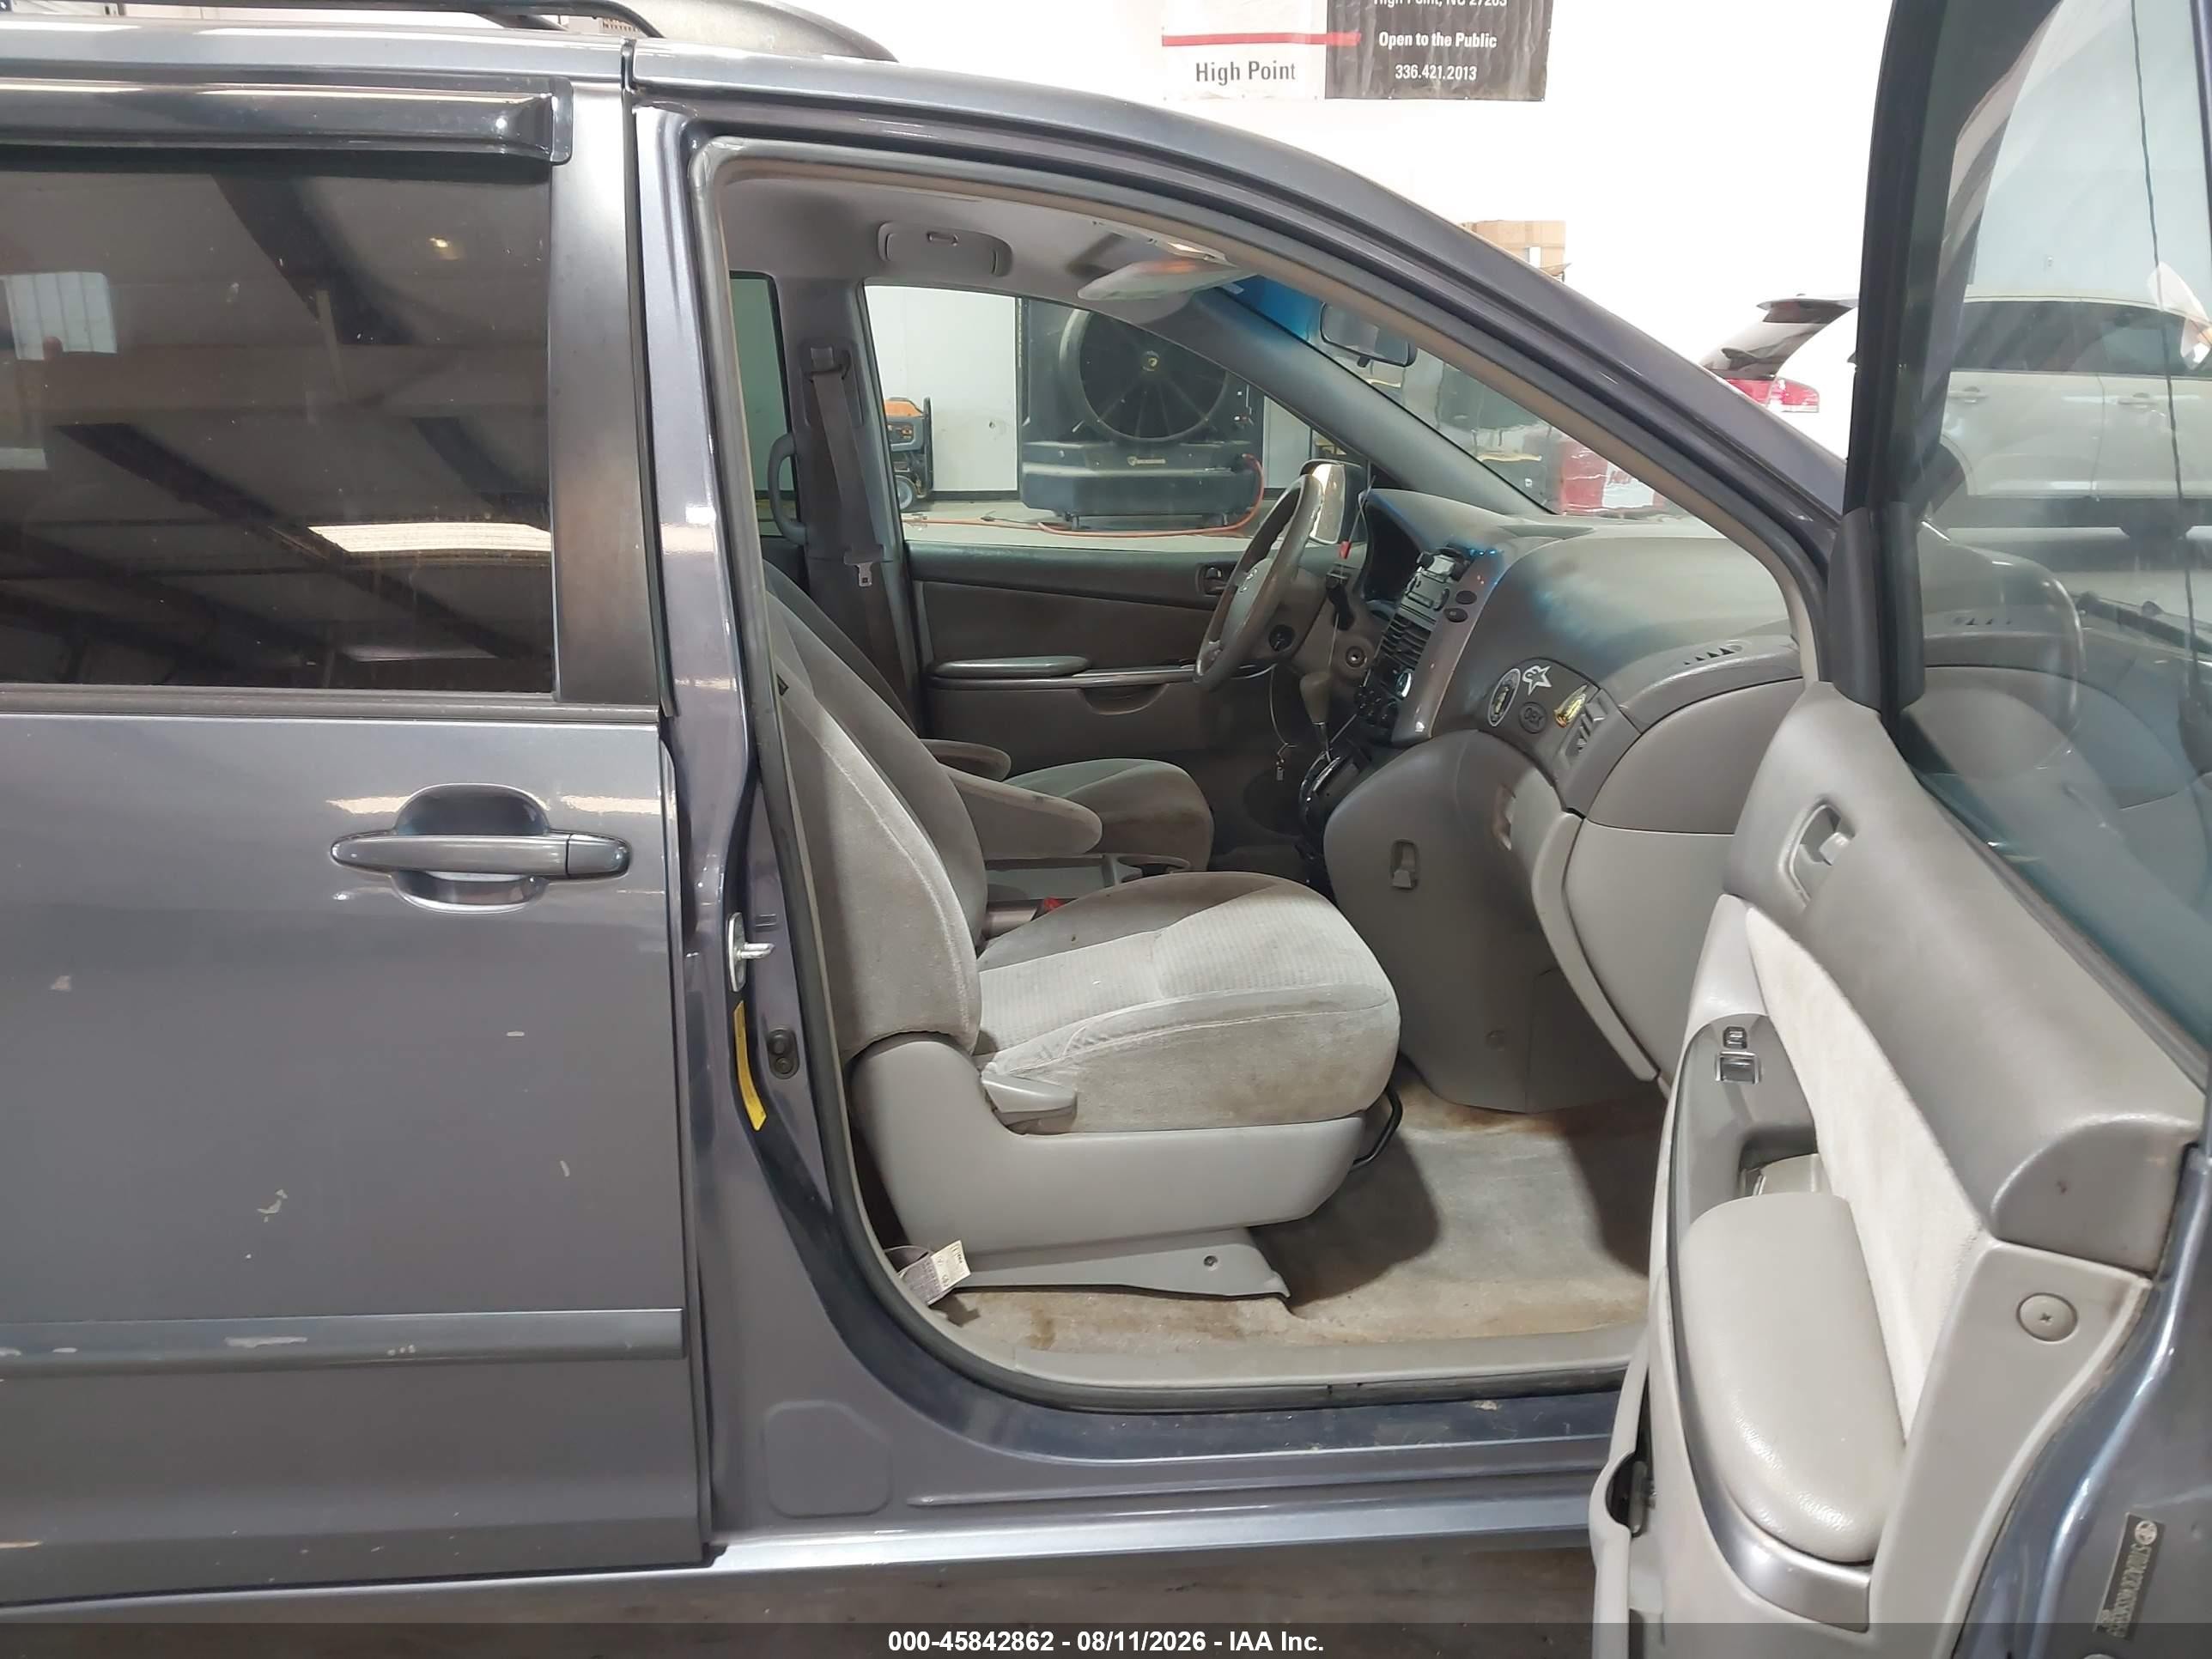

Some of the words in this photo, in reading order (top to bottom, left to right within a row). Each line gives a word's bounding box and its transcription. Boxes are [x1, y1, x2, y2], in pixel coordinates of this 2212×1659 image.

[1378, 31, 1413, 51] Open
[1415, 33, 1430, 46] to
[1431, 32, 1452, 47] the
[1455, 32, 1498, 48] Public
[1195, 61, 1240, 87] High
[1248, 59, 1296, 81] Point
[1395, 64, 1478, 81] 336.421.2013
